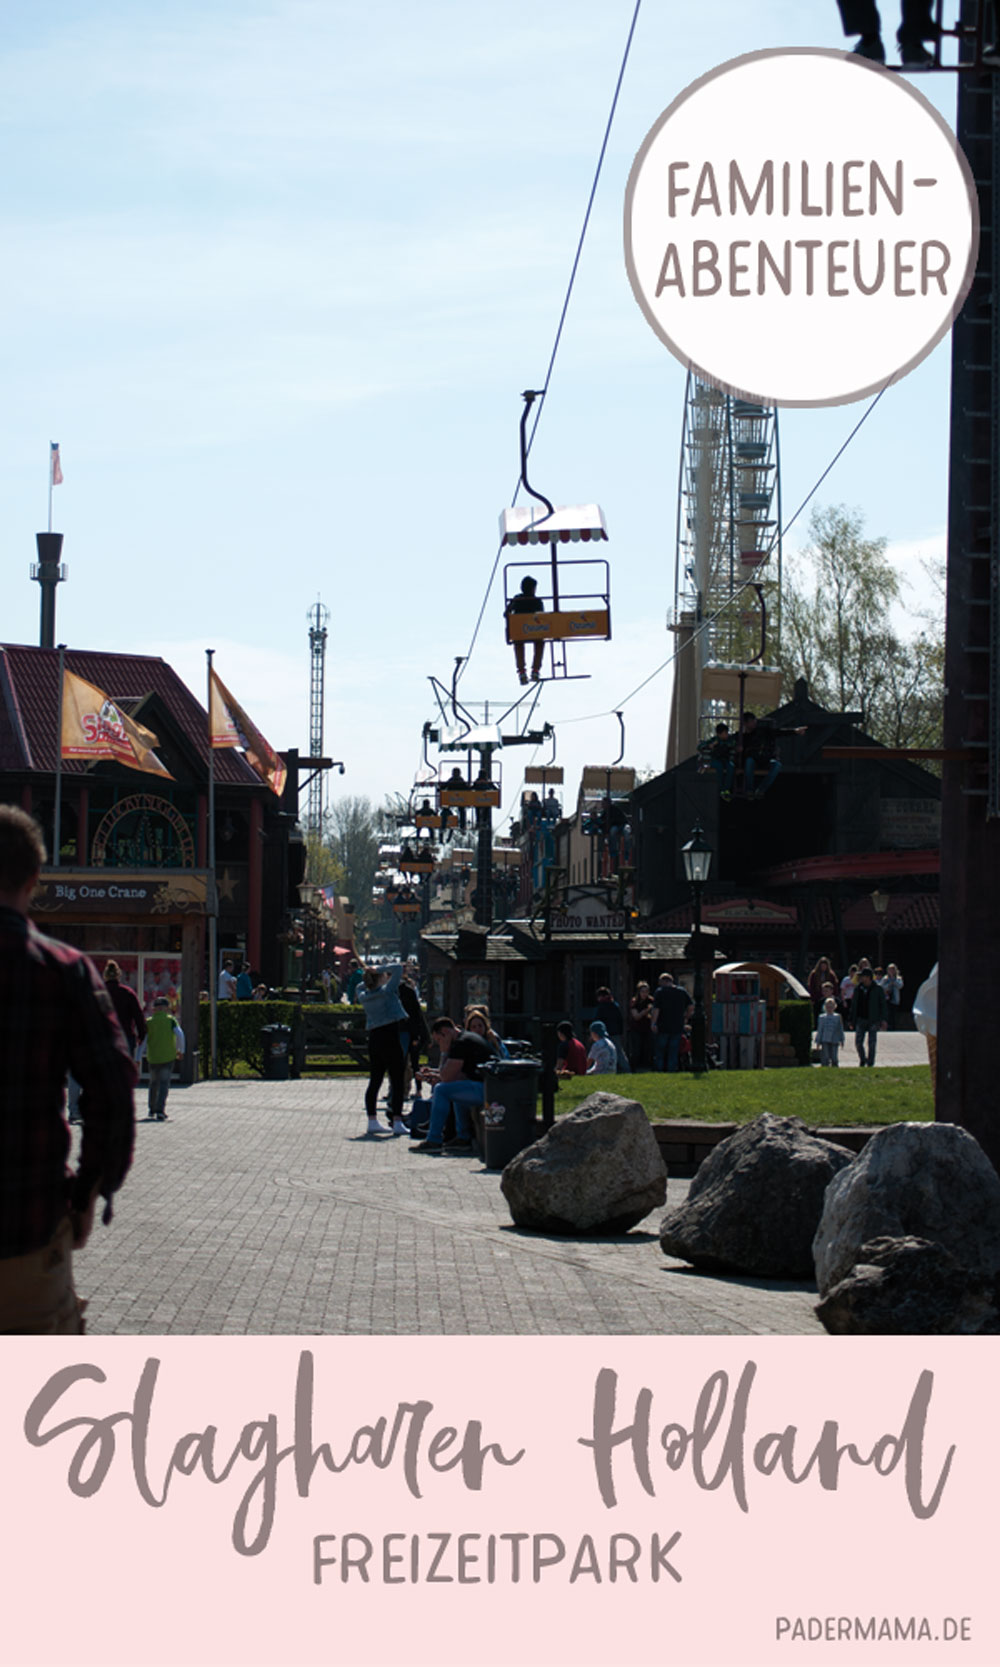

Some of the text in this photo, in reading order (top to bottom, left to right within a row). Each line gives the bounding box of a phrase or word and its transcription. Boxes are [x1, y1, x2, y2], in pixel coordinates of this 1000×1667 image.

[55, 885, 147, 900] Big One Crane
[550, 913, 625, 928] PHOTO WANTED
